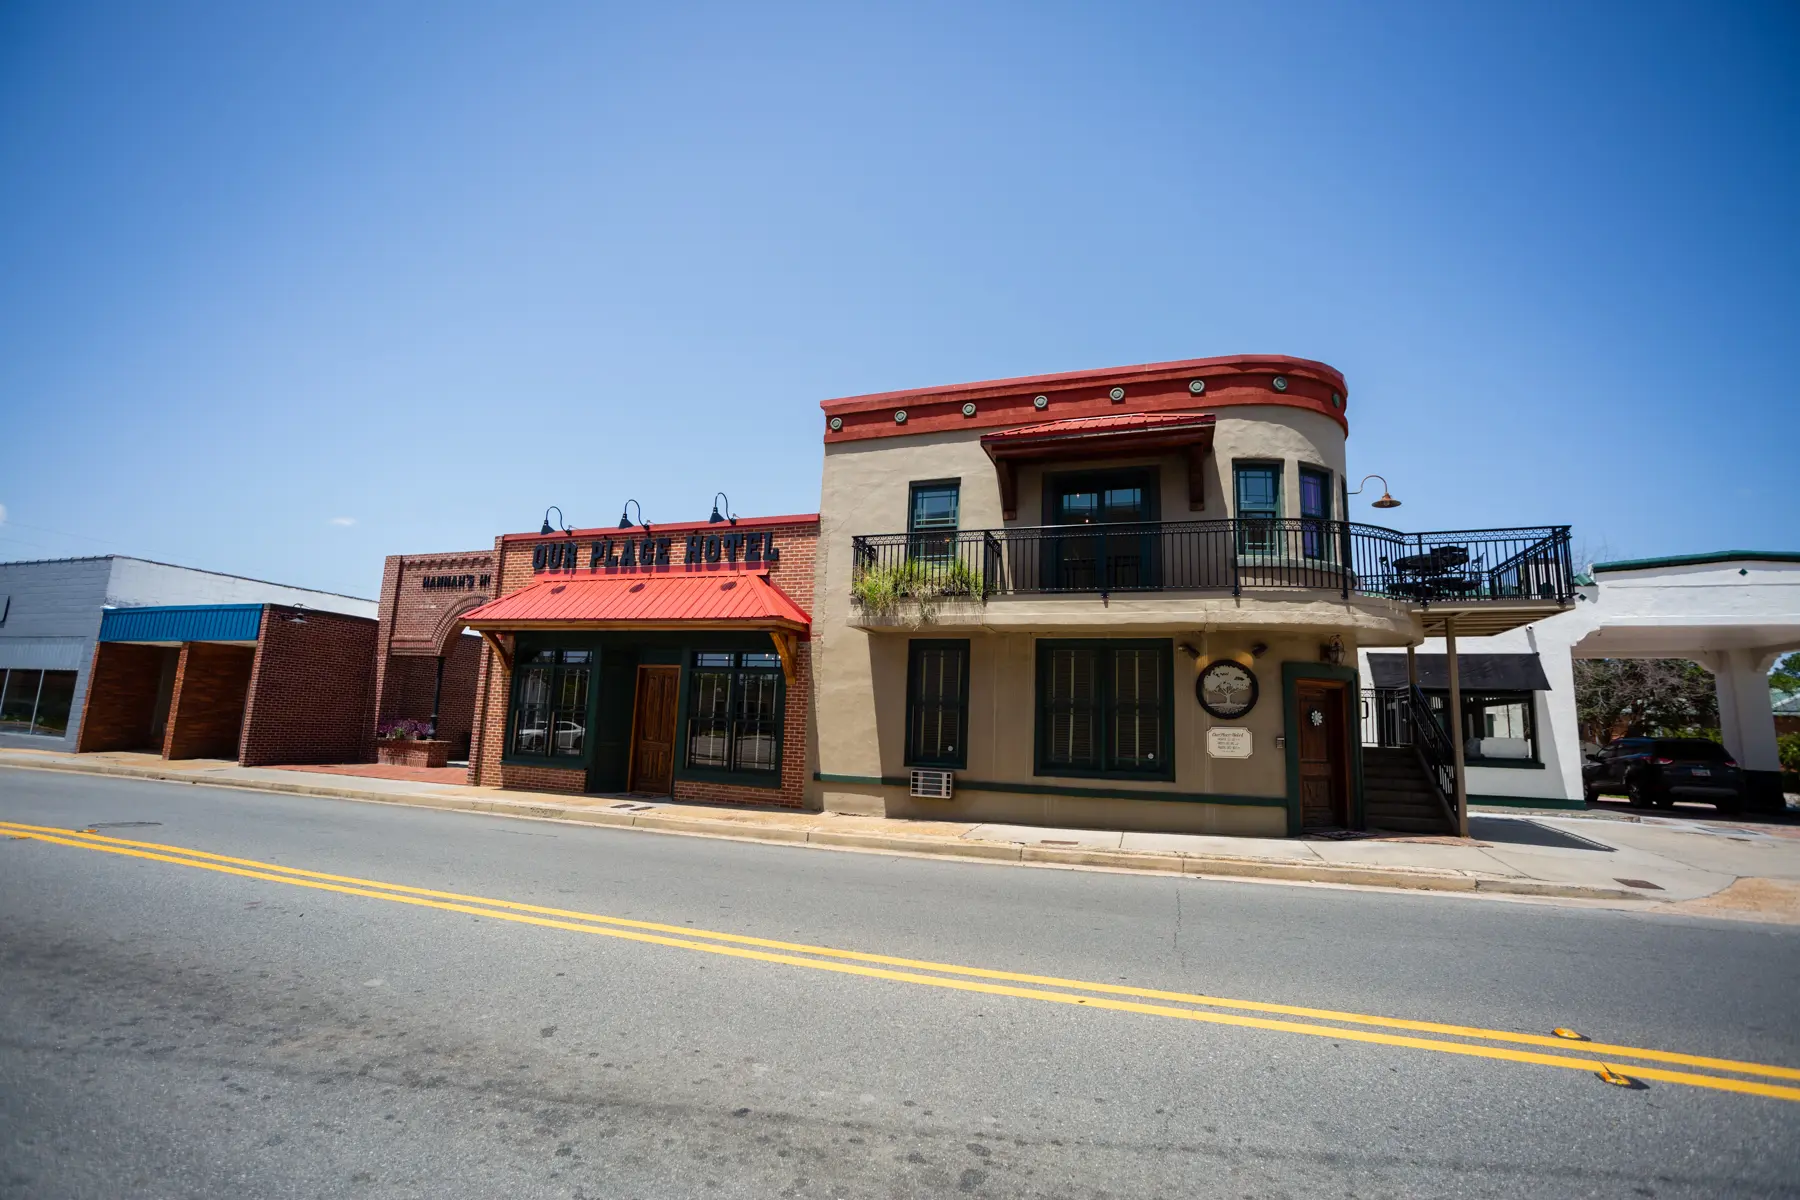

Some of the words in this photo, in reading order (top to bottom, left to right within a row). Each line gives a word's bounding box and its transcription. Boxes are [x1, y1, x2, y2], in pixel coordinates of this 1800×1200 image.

[532, 542, 577, 569] OUR
[589, 537, 671, 568] PLACE
[684, 532, 779, 564] HOTEL
[422, 574, 475, 589] HANNAH'S
